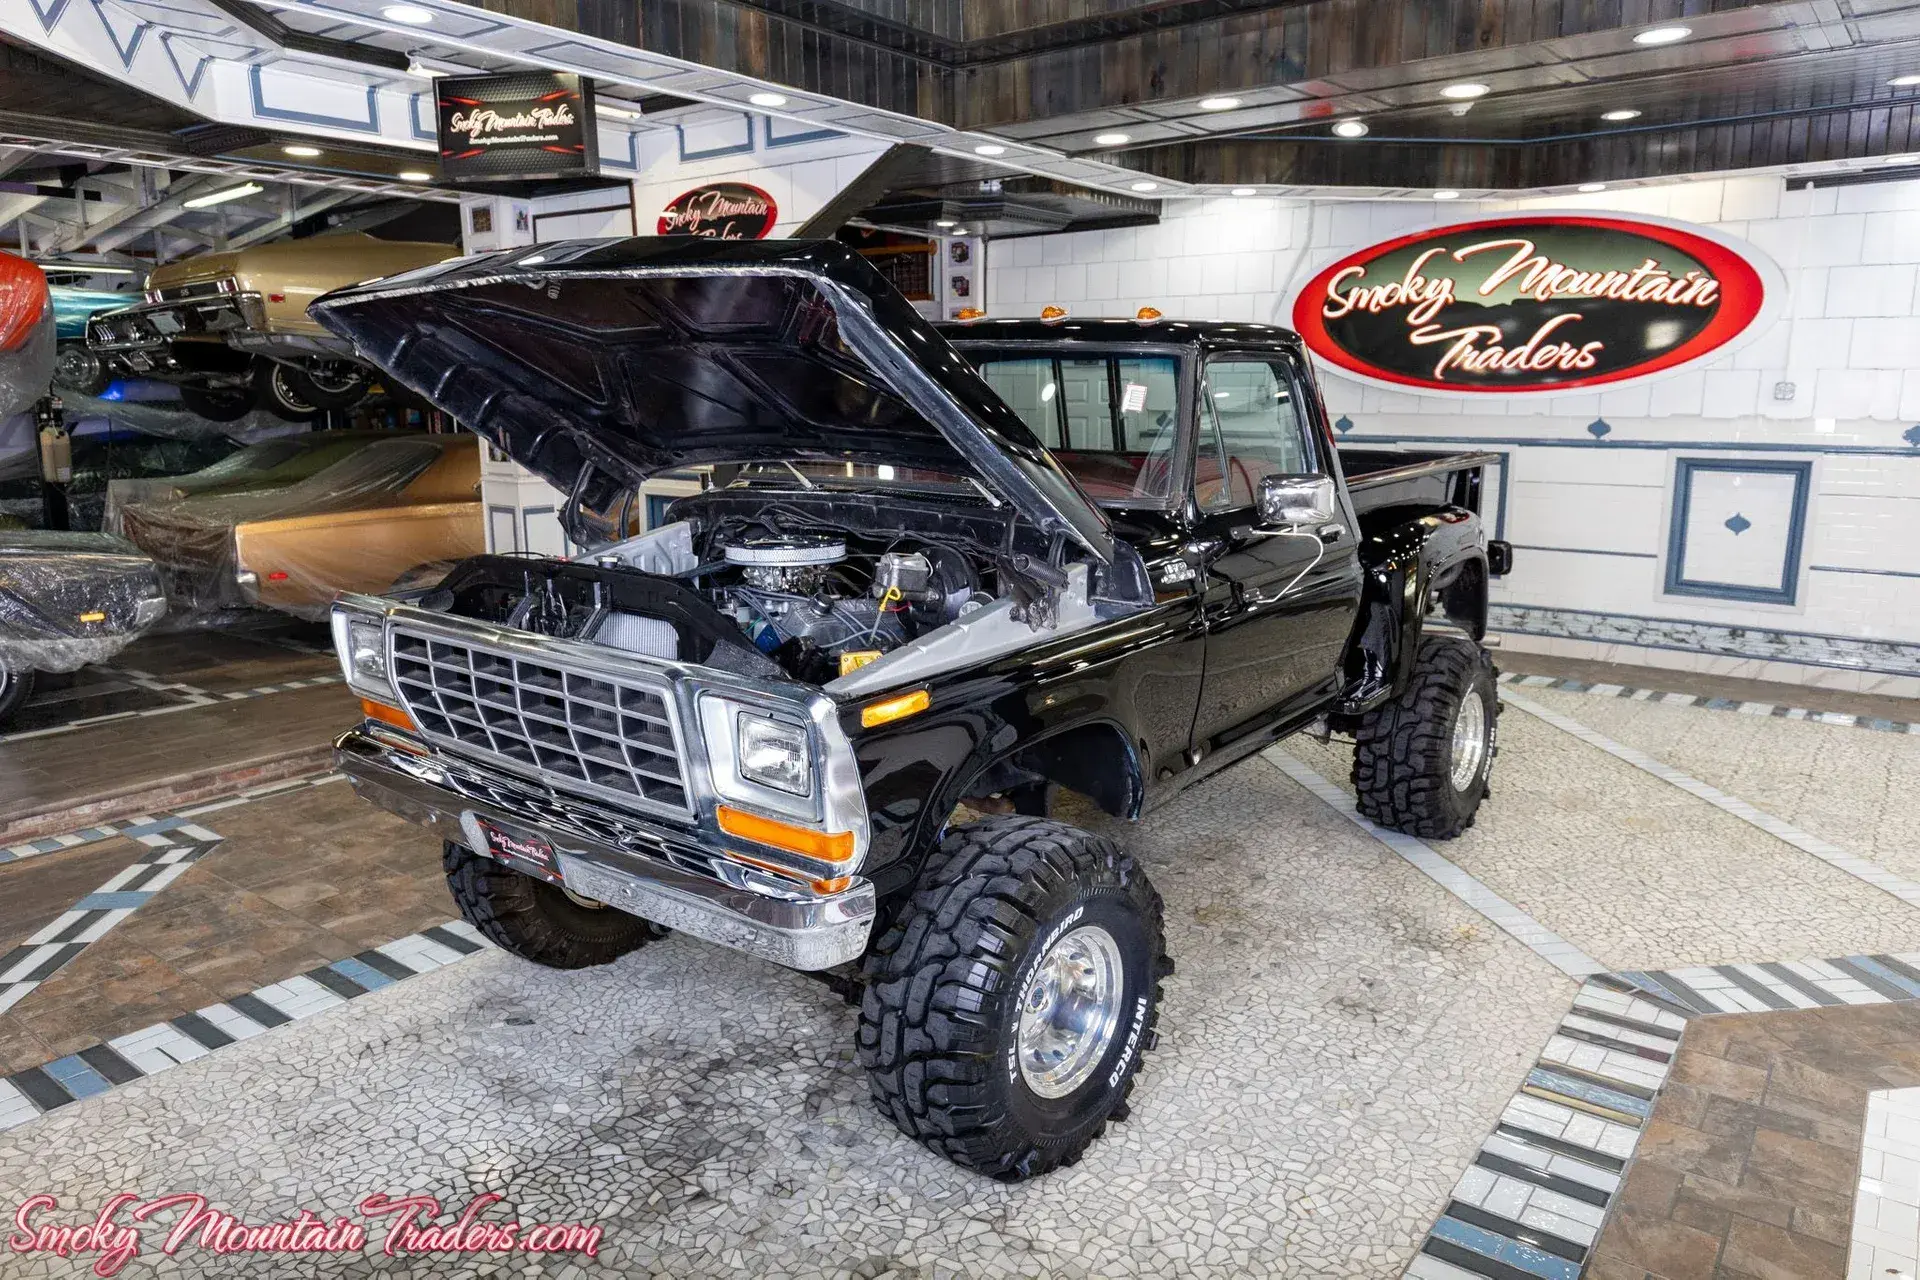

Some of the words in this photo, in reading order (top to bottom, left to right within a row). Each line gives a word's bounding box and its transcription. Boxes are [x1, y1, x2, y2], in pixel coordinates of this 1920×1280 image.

[451, 108, 483, 138] Smoky
[477, 109, 537, 132] Mountain
[531, 102, 575, 130] Traders
[699, 190, 769, 217] Mountain
[1322, 247, 1455, 325] Smoky
[1453, 238, 1721, 308] Mountain
[1410, 313, 1604, 380] Traders
[1008, 1038, 1018, 1084] TSL
[1014, 906, 1085, 1013] THORNBIRD
[1108, 997, 1148, 1088] INTERCO
